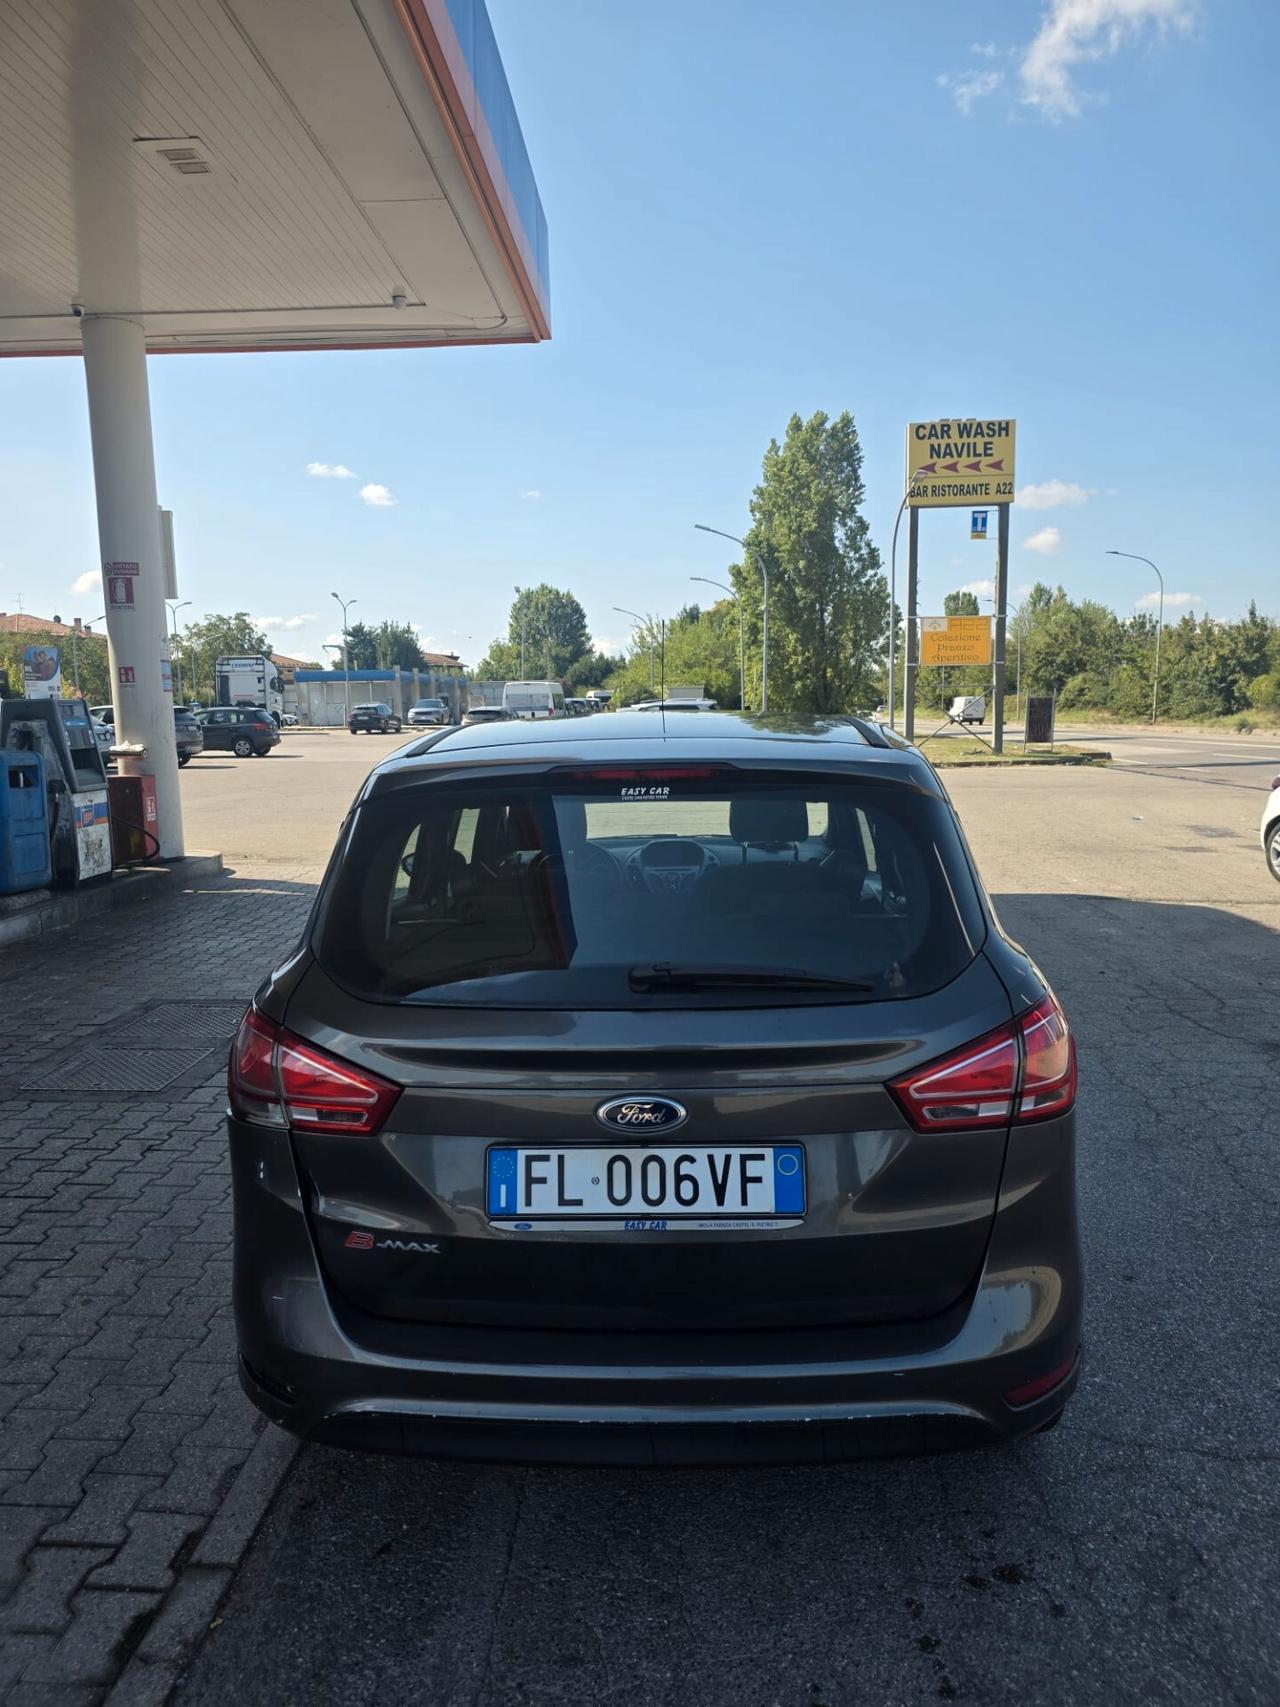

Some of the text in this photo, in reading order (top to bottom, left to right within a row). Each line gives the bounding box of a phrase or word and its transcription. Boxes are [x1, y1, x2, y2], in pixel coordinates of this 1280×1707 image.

[915, 421, 1010, 440] CAR WASH
[929, 441, 994, 459] NAVILE
[909, 482, 1013, 498] BAR RISTORANTE A22
[930, 632, 982, 642] Colazione
[936, 643, 975, 653] Pranzo
[621, 786, 670, 796] EASY CAR
[616, 1103, 666, 1125] Ford
[524, 1153, 766, 1207] FL 006VF
[624, 1220, 668, 1231] EASY CAR
[344, 1231, 441, 1254] B-MAX
